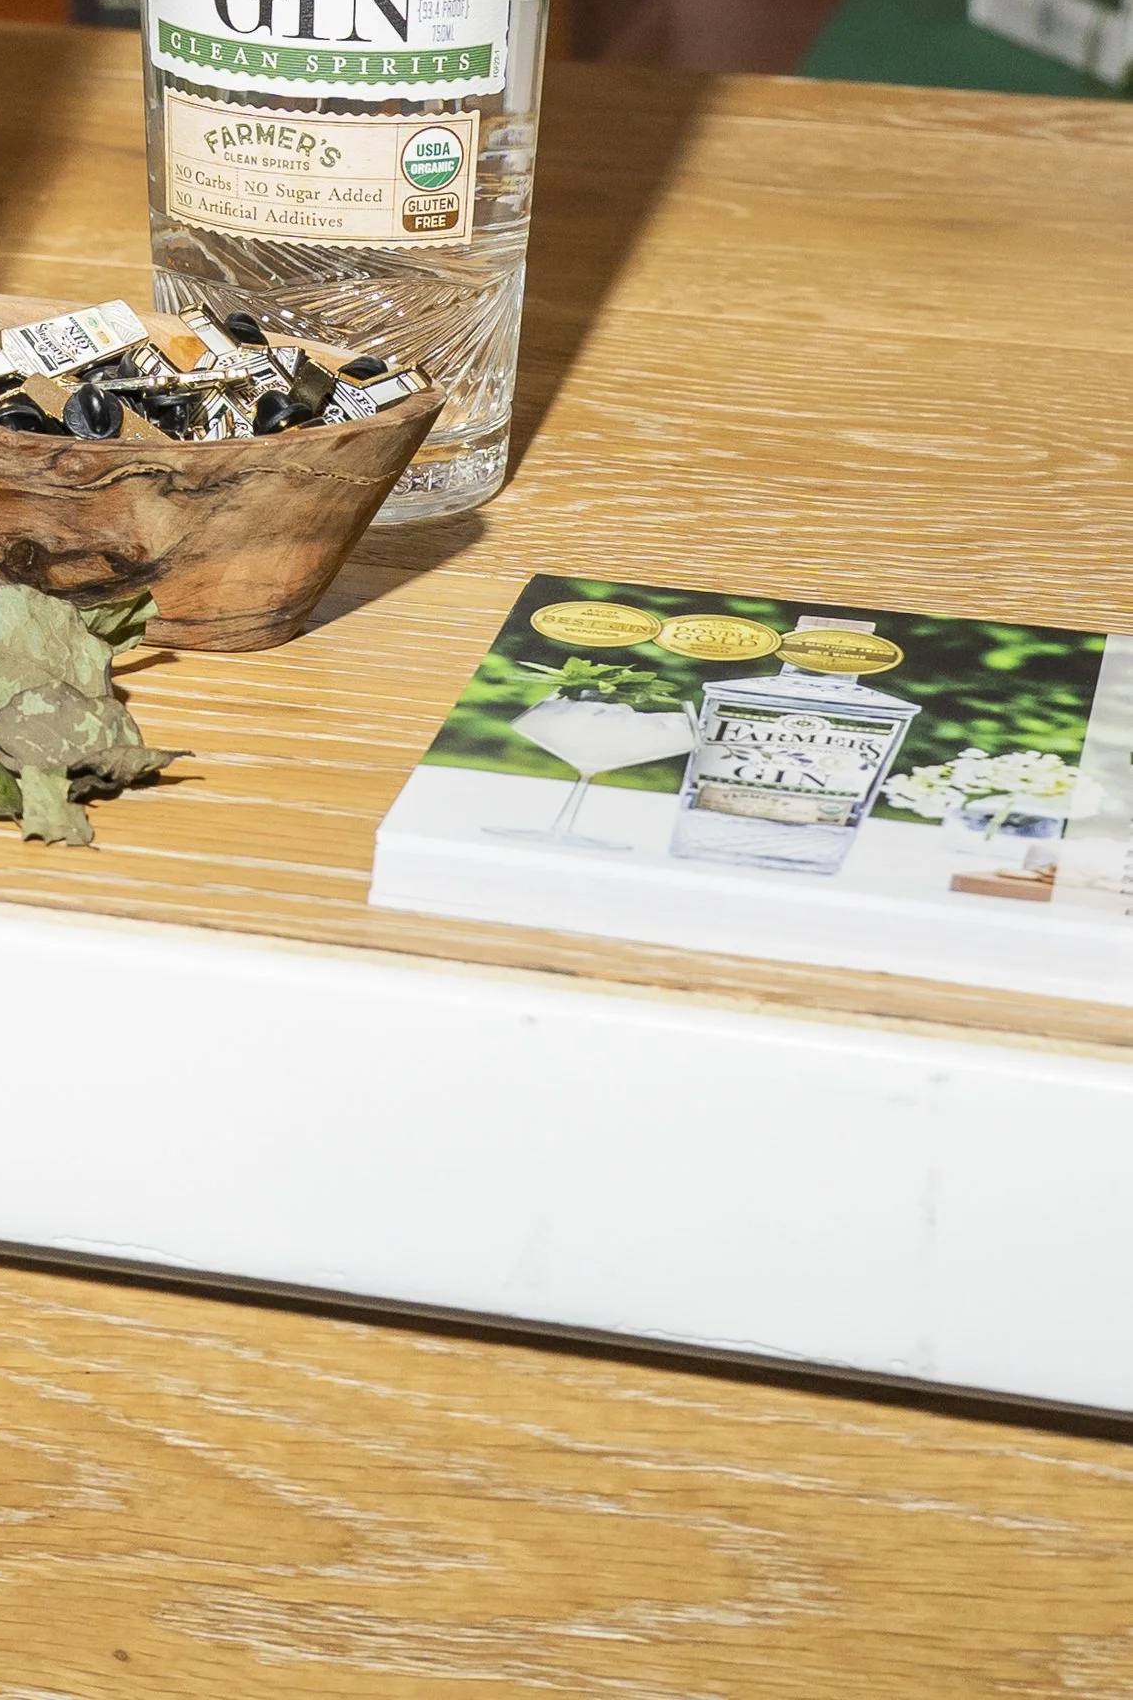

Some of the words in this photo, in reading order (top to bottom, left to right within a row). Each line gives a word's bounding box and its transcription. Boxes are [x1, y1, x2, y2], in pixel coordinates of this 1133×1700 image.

[170, 32, 279, 70] CLEAN
[306, 52, 471, 75] SPIRITS
[203, 122, 341, 168] FARMER'S
[416, 142, 450, 156] USDA
[224, 152, 258, 166] CLEAN
[262, 158, 310, 171] SPIRITS
[410, 161, 455, 175] ORGANIC
[175, 164, 192, 180] NO
[195, 171, 232, 191] Carbs
[244, 180, 269, 196] NO
[276, 183, 321, 204] Sugar
[329, 188, 383, 203] Added
[175, 191, 193, 207] NO
[198, 197, 257, 221] Artificial
[265, 209, 343, 228] Additives
[408, 197, 455, 212] GLUTEN
[415, 215, 446, 229] FREE
[541, 614, 598, 628] BEST
[673, 632, 757, 647] GOLD
[676, 626, 759, 640] DOUBLE
[734, 765, 830, 788] GIN
